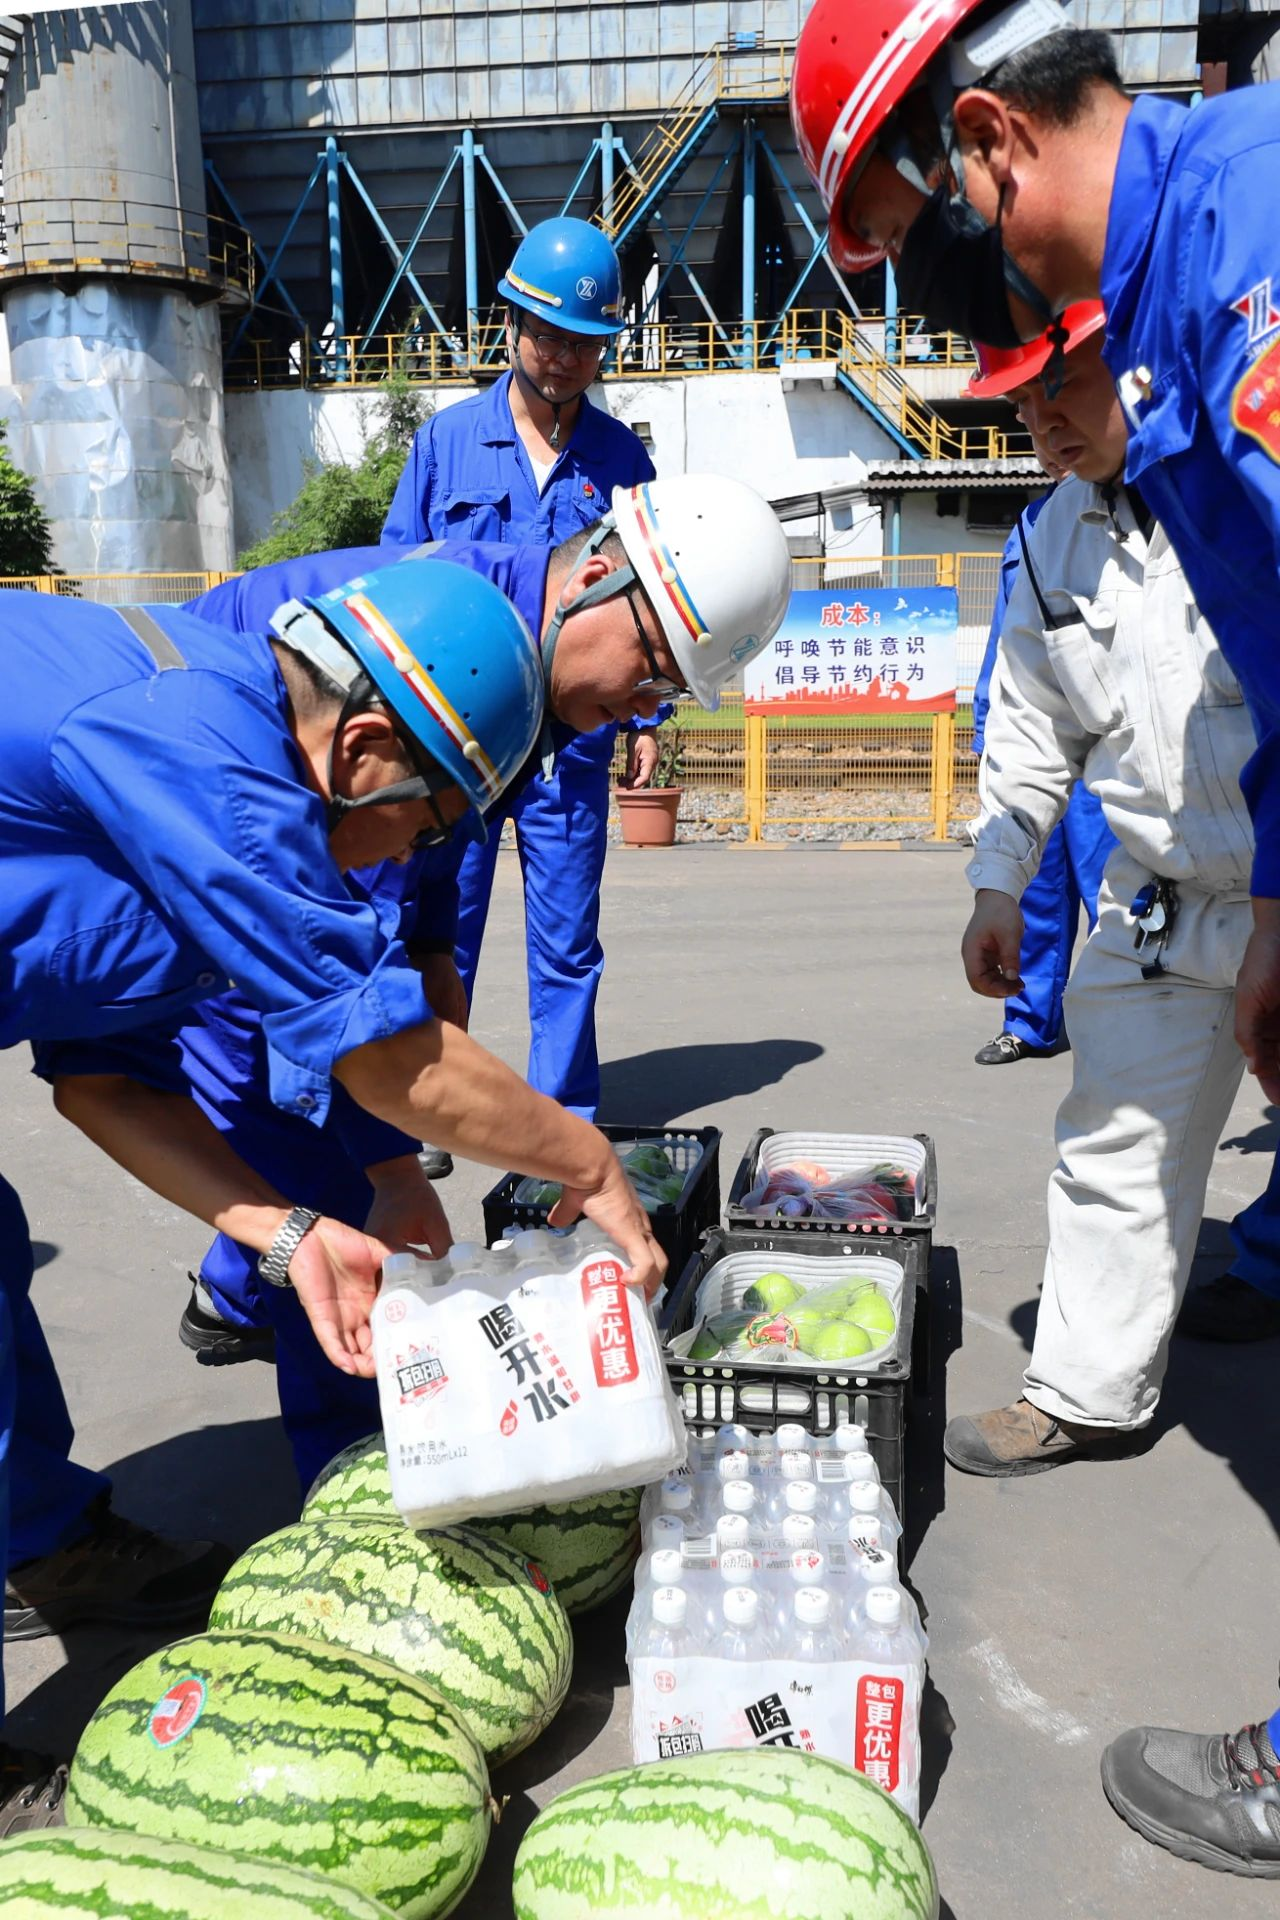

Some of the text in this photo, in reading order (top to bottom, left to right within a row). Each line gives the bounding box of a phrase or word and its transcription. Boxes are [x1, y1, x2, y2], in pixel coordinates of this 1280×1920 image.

[821, 602, 881, 627] 成本:
[774, 636, 926, 658] 呼唤节能意识
[774, 663, 925, 686] 倡导节约行为
[591, 1285, 632, 1380] 更优惠
[478, 1303, 571, 1424] 喝开水
[865, 1681, 897, 1699] 整包
[863, 1699, 893, 1790] 更优惠
